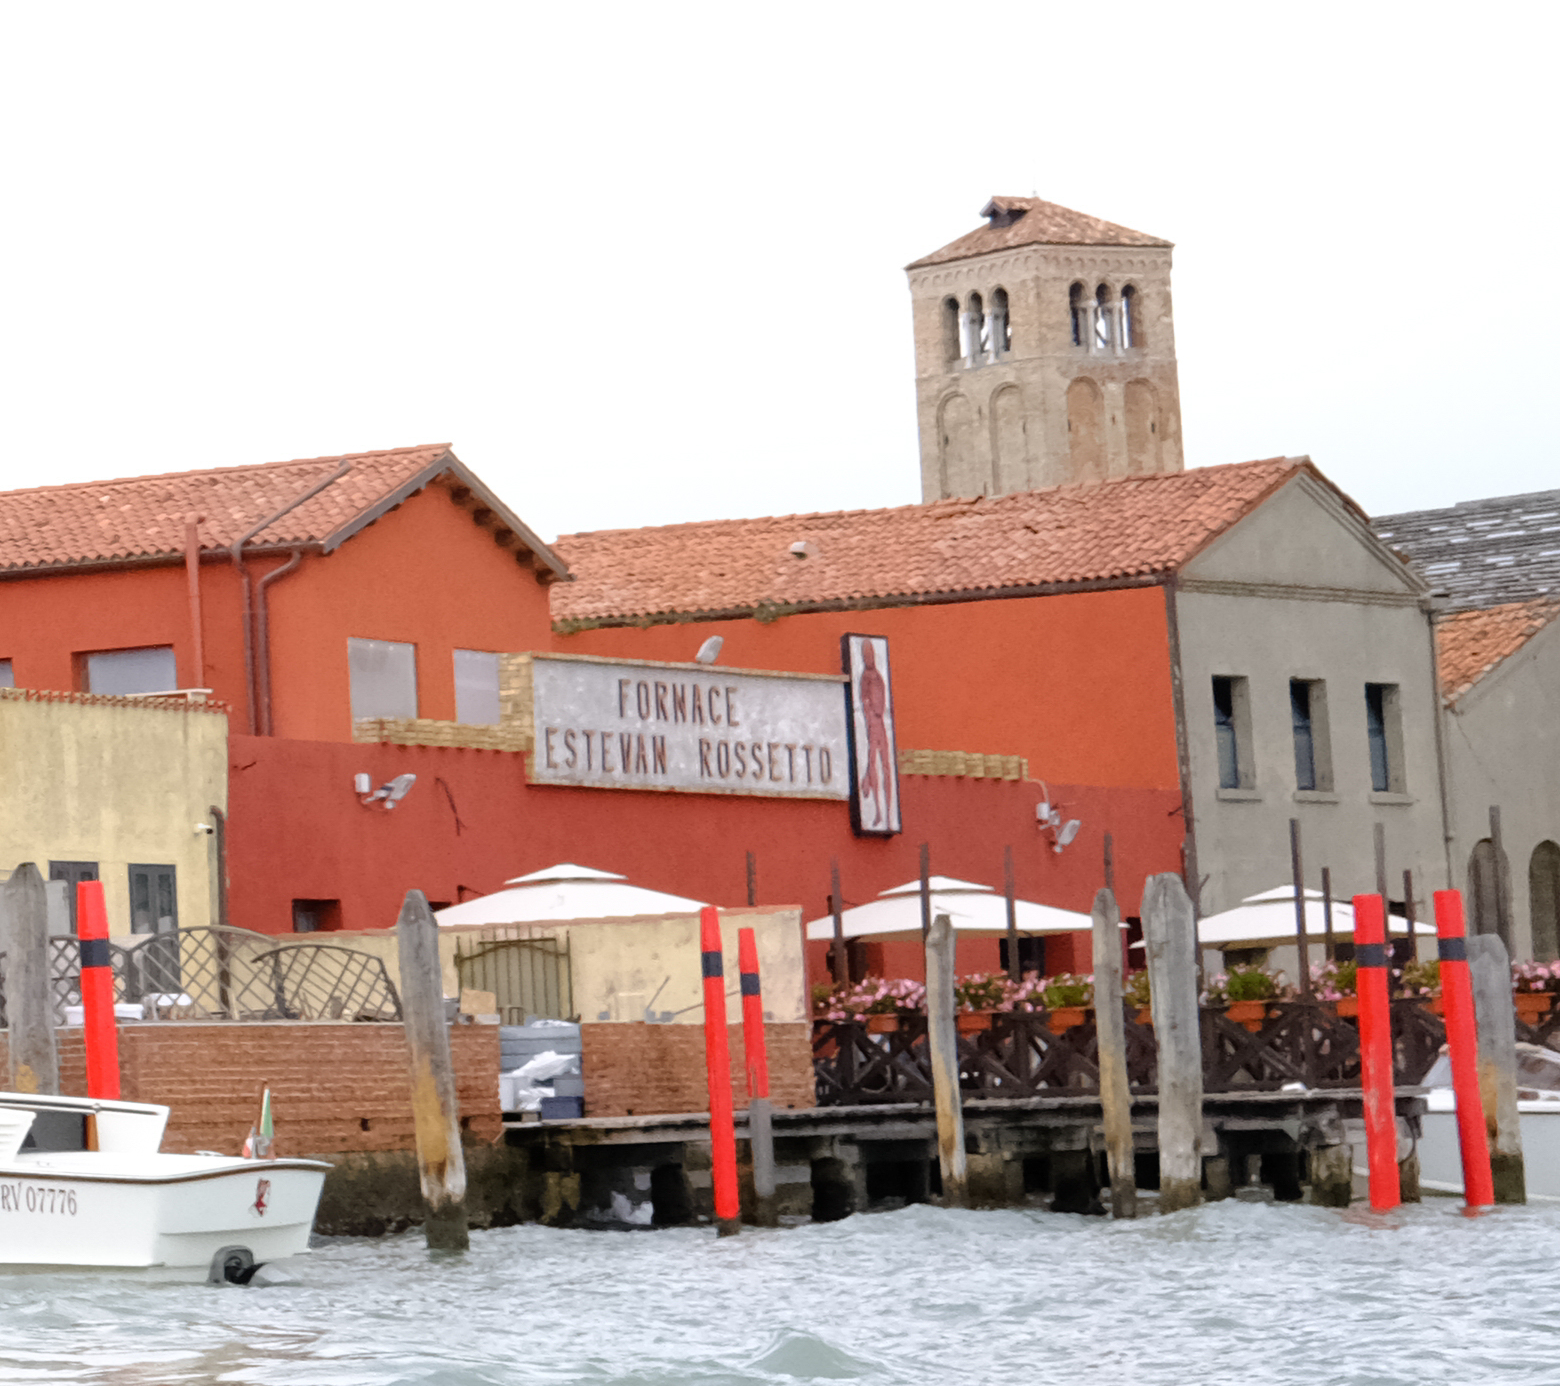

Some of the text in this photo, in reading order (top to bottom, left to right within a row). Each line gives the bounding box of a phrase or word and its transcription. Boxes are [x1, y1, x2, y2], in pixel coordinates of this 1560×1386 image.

[618, 678, 740, 727] FORNACE
[545, 726, 832, 784] ESTEVAN ROSSETTO
[0, 1181, 77, 1216] RV 07776
